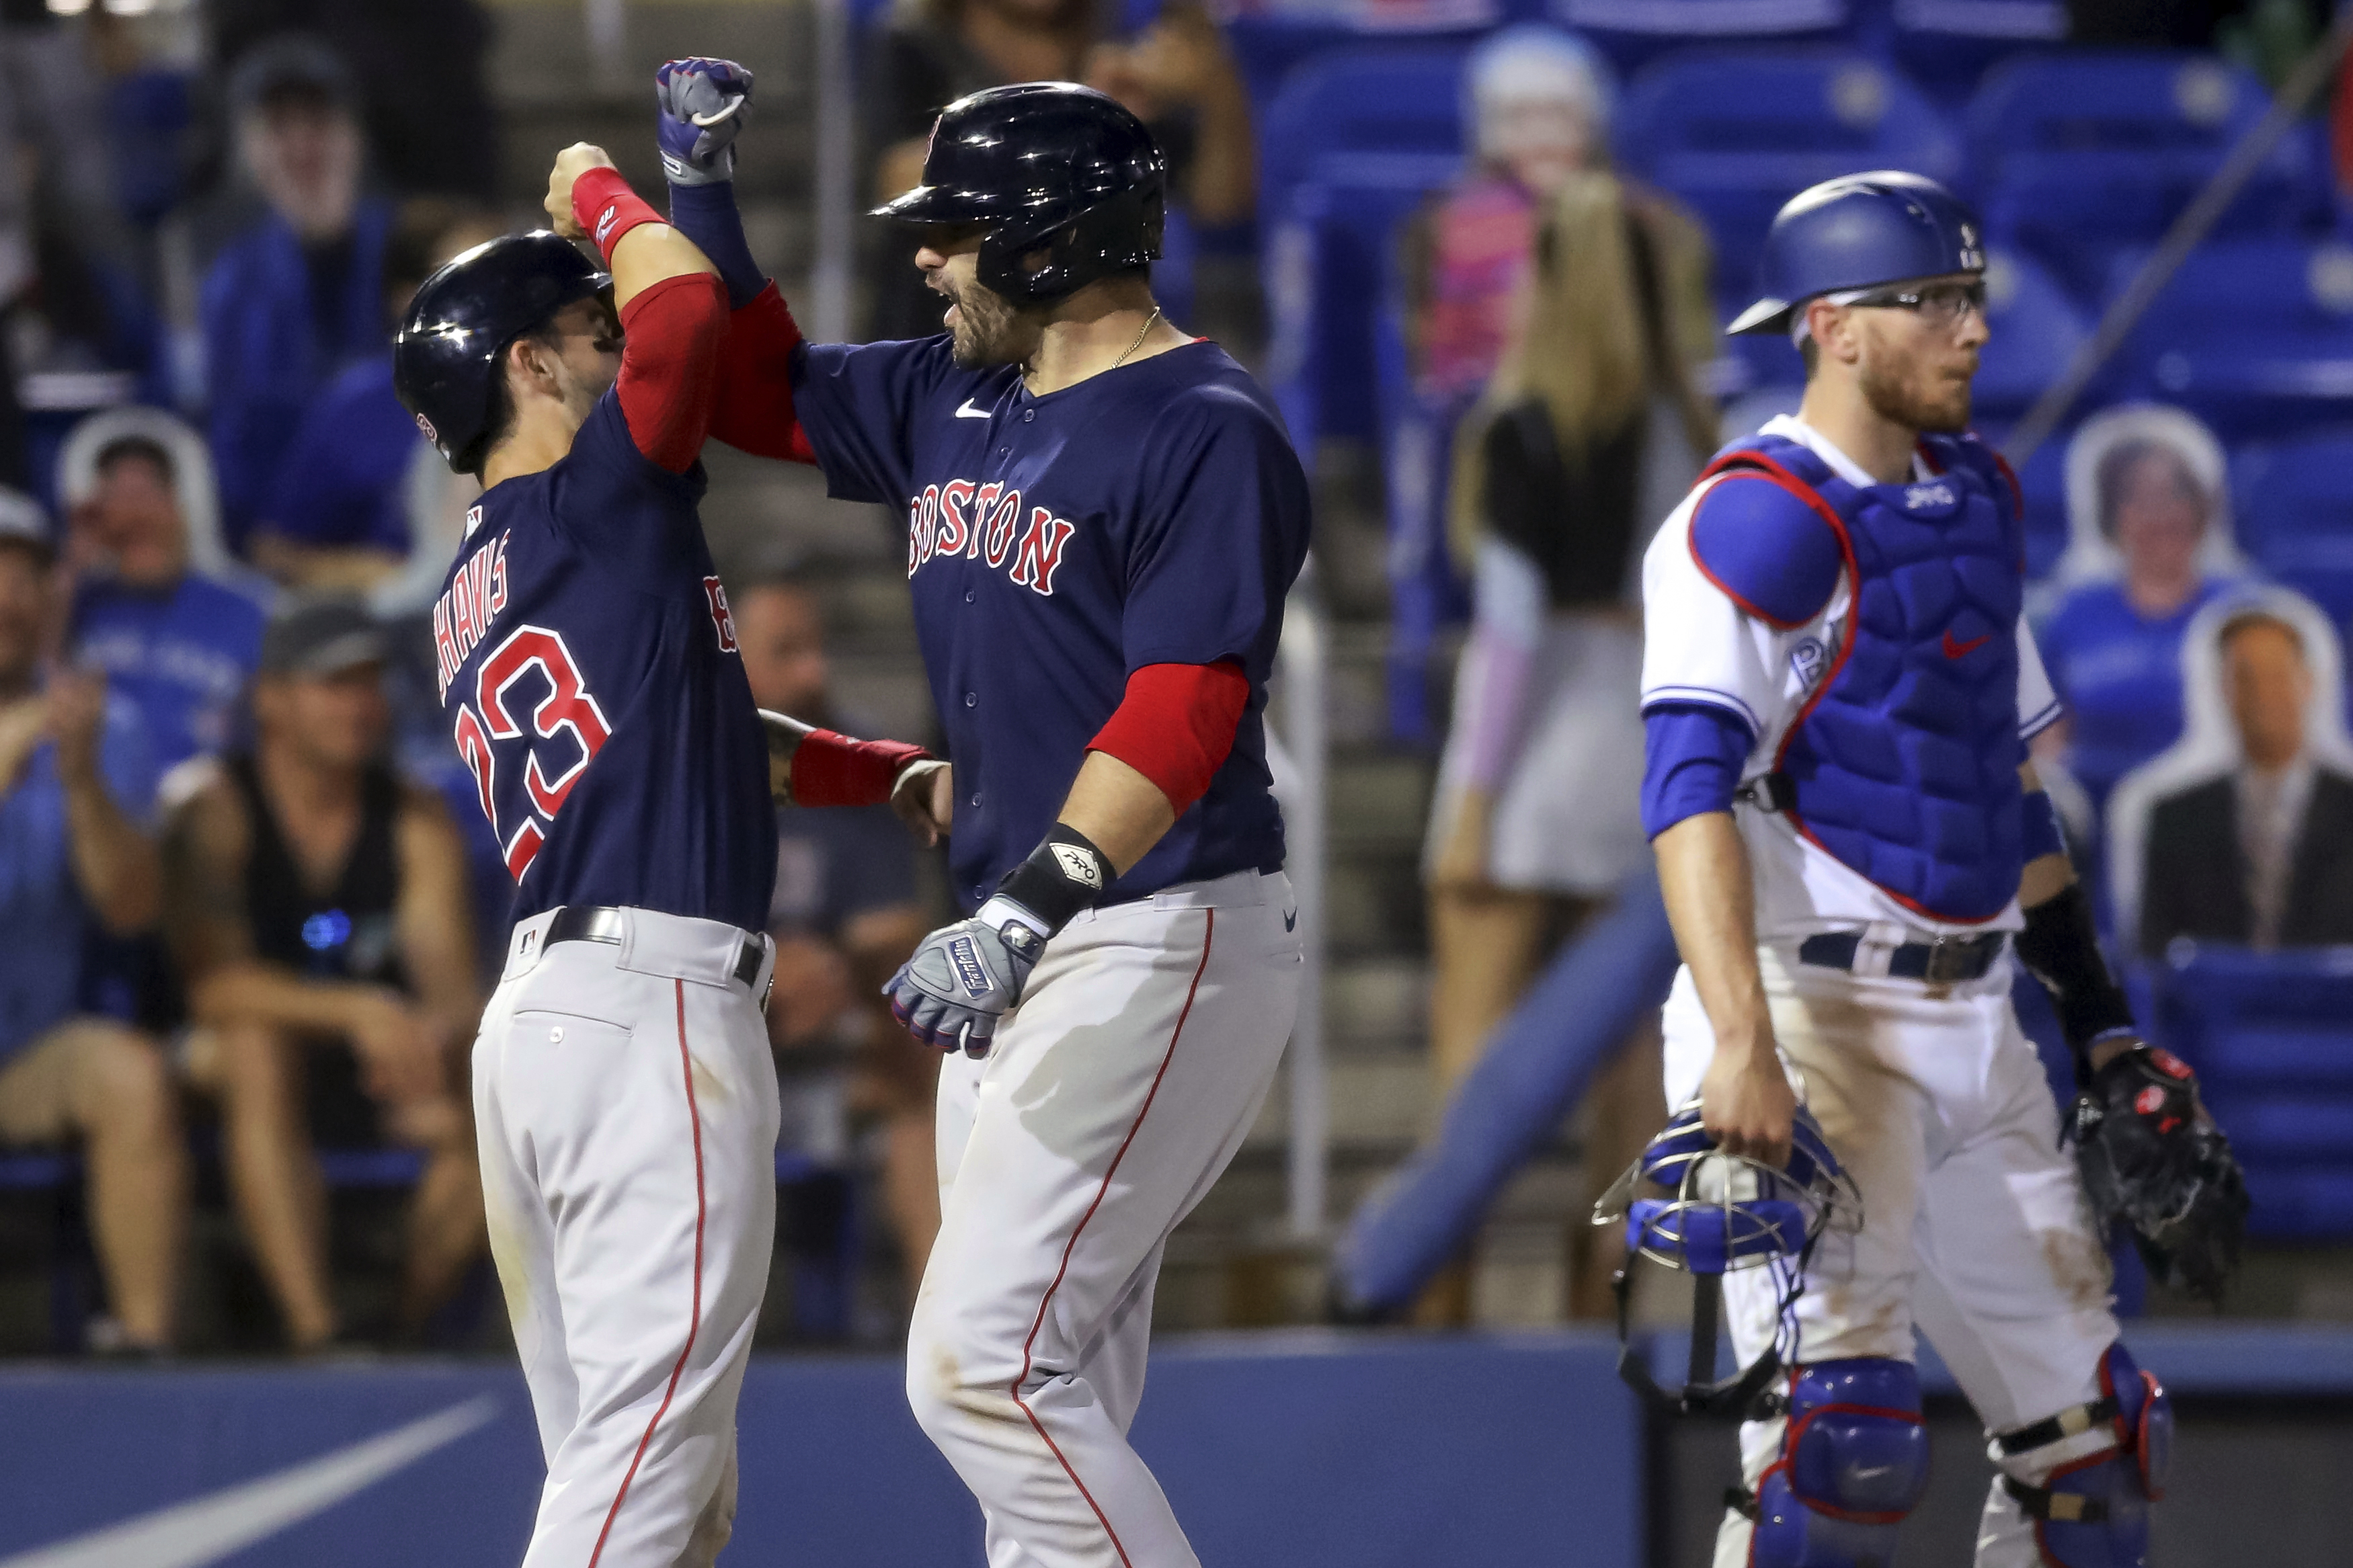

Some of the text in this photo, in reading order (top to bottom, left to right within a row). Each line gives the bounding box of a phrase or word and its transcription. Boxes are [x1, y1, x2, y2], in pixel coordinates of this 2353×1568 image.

[908, 479, 1075, 596] BOSTON
[455, 624, 612, 886] 23
[1063, 851, 1094, 880] PRO
[955, 940, 988, 989] Franklin
